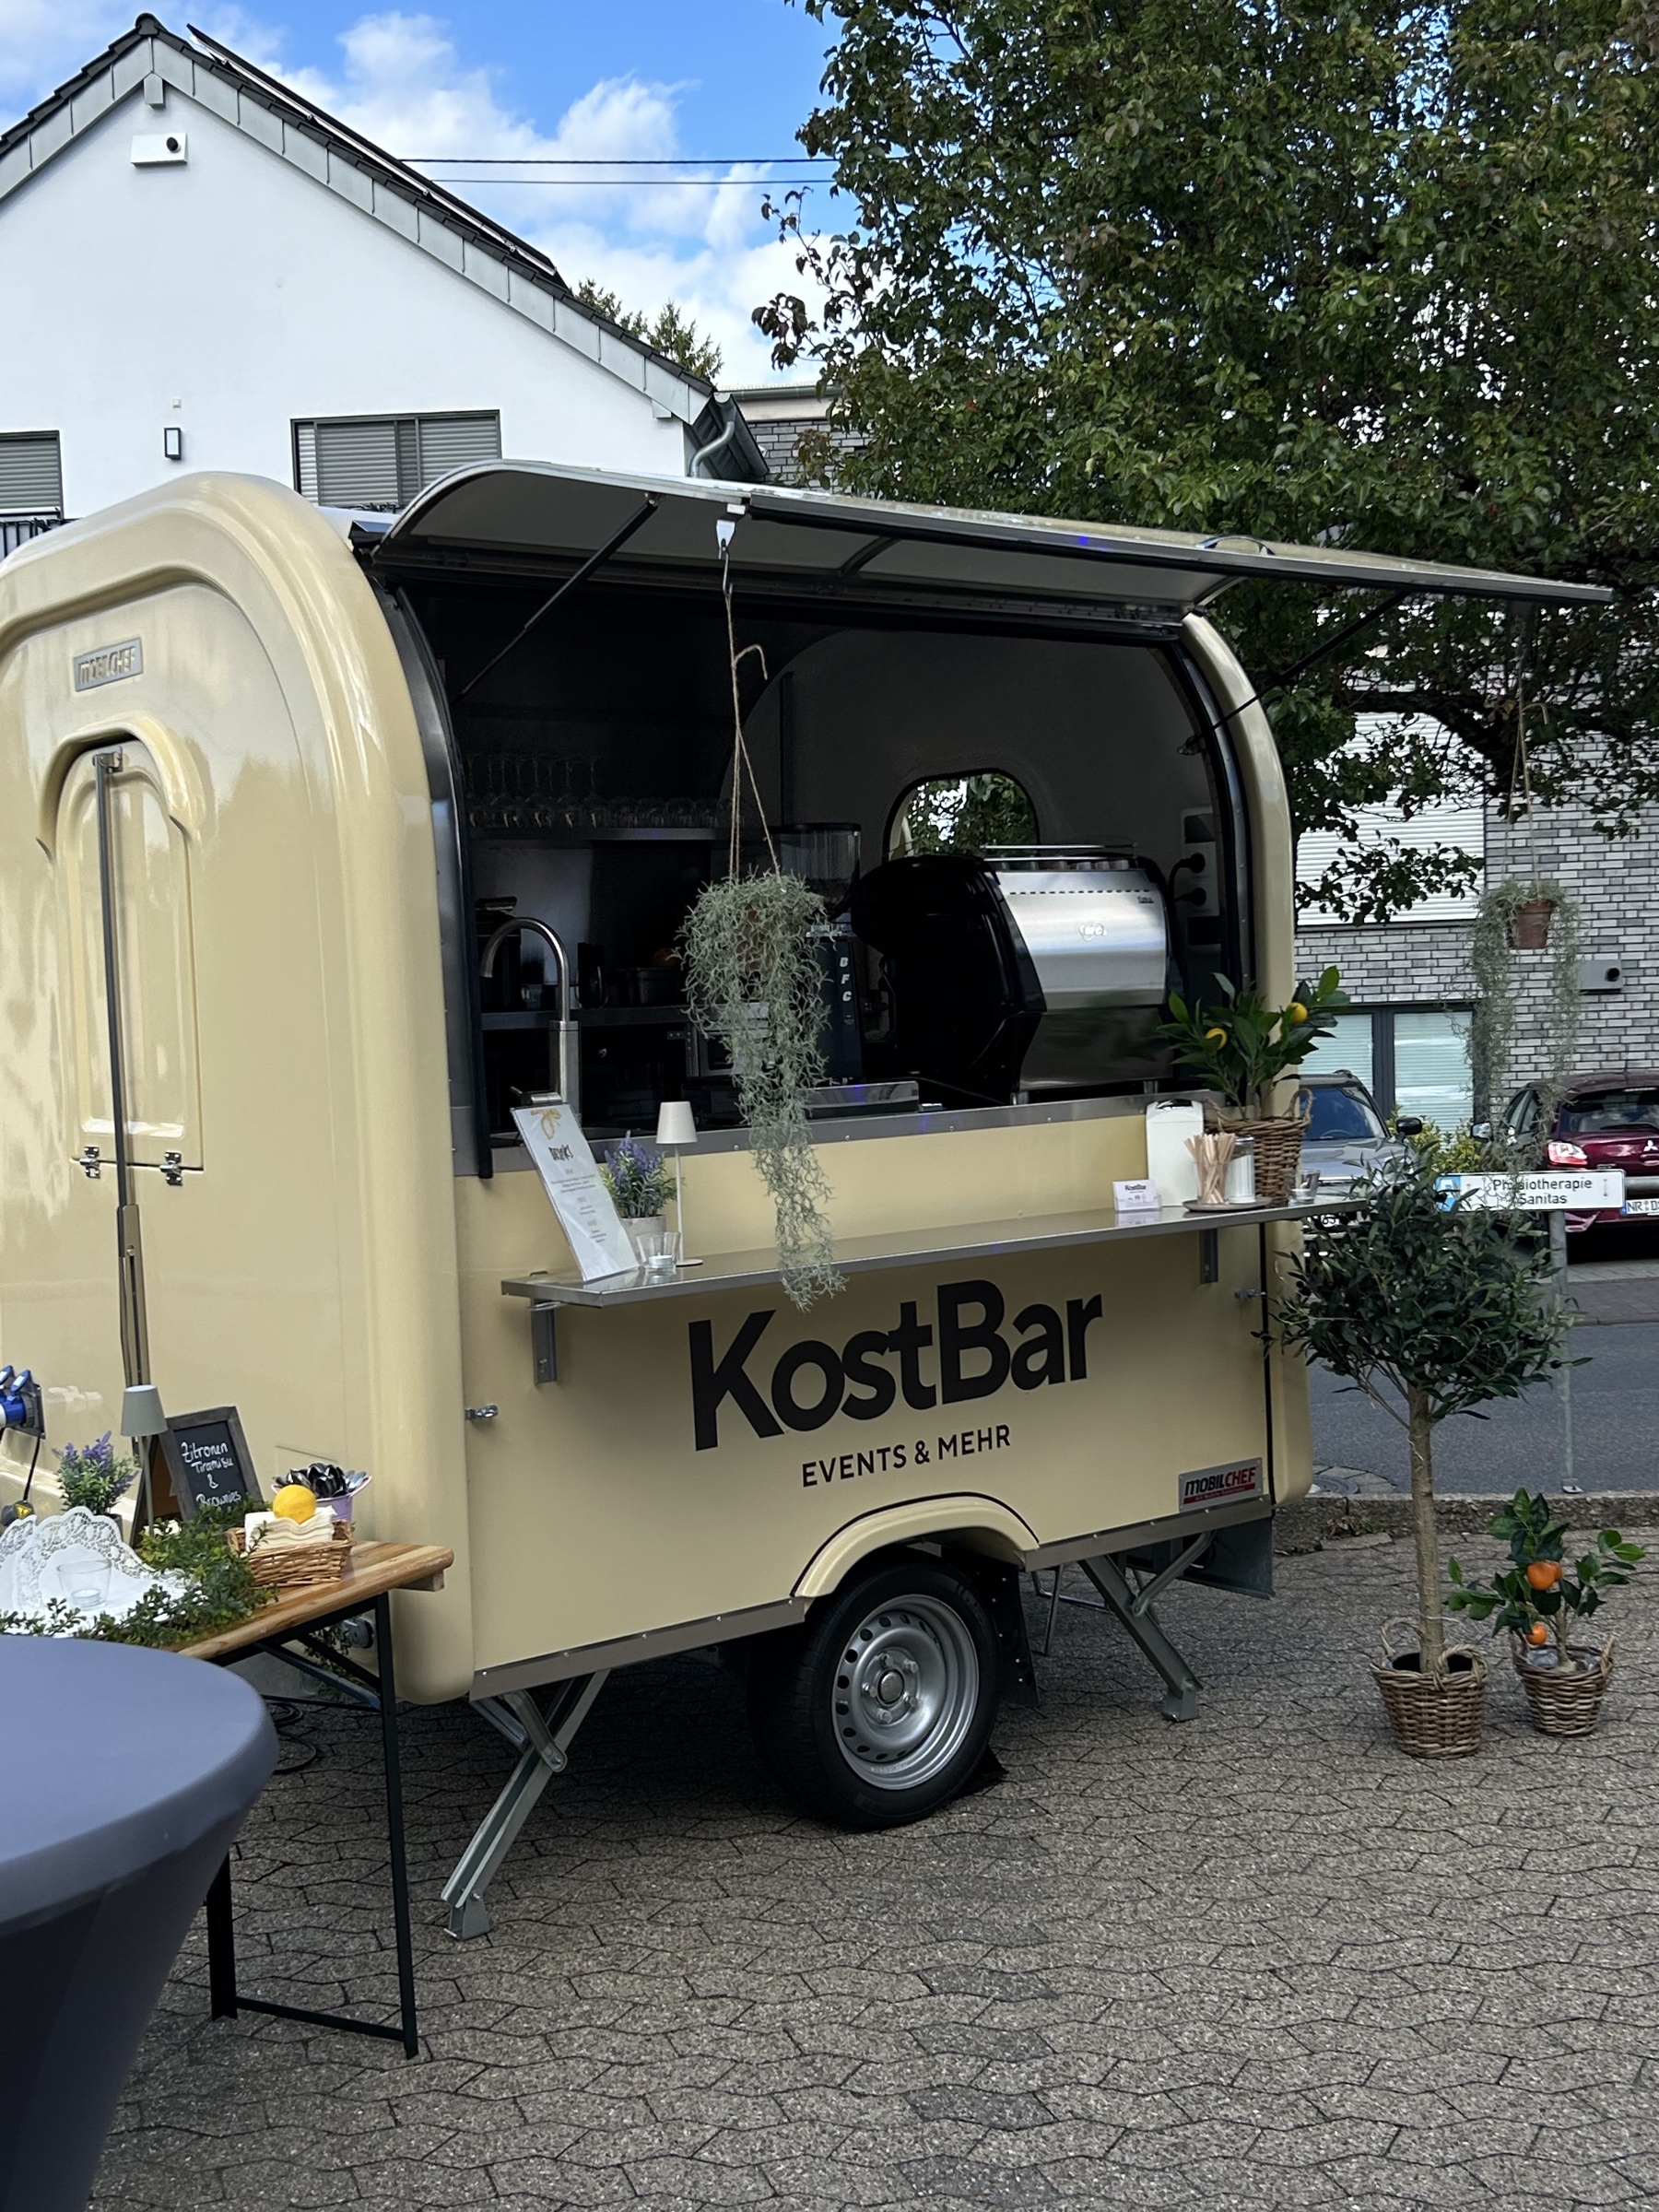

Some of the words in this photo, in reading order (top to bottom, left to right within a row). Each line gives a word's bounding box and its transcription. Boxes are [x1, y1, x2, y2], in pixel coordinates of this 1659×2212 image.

[839, 957, 852, 1002] BFC
[1520, 1193, 1568, 1205] Sanitas
[688, 1279, 1103, 1452] KostBar
[181, 1441, 229, 1464] Zitronen
[802, 1444, 907, 1488] EVENTS
[914, 1441, 930, 1465] &
[938, 1424, 1010, 1460] MEHR
[206, 1473, 219, 1488] &
[1184, 1466, 1256, 1497] MOBILCHEF
